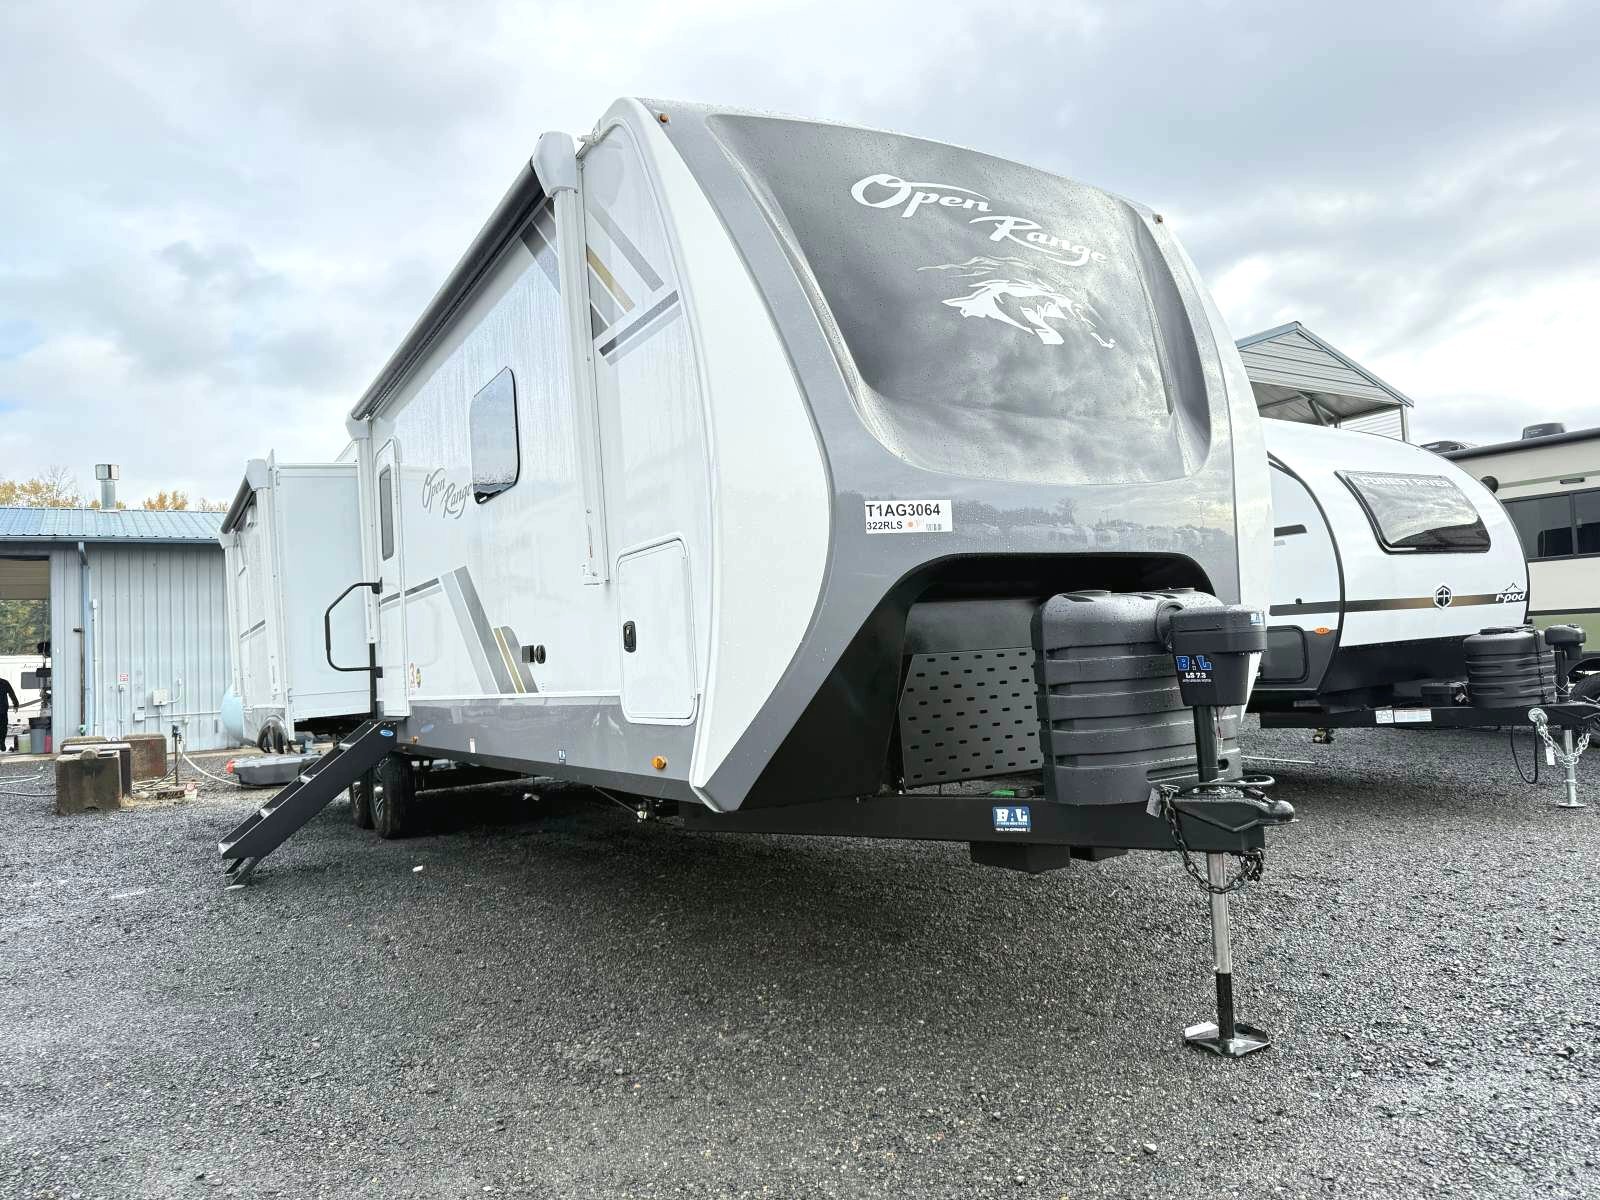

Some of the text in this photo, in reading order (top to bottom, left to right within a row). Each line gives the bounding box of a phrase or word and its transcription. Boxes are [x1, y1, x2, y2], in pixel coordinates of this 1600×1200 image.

[850, 173, 993, 218] Open
[968, 215, 1108, 267] Range
[422, 467, 447, 513] Open
[440, 482, 473, 519] Range
[865, 503, 941, 517] T1AG3064
[866, 521, 903, 530] 322RLS
